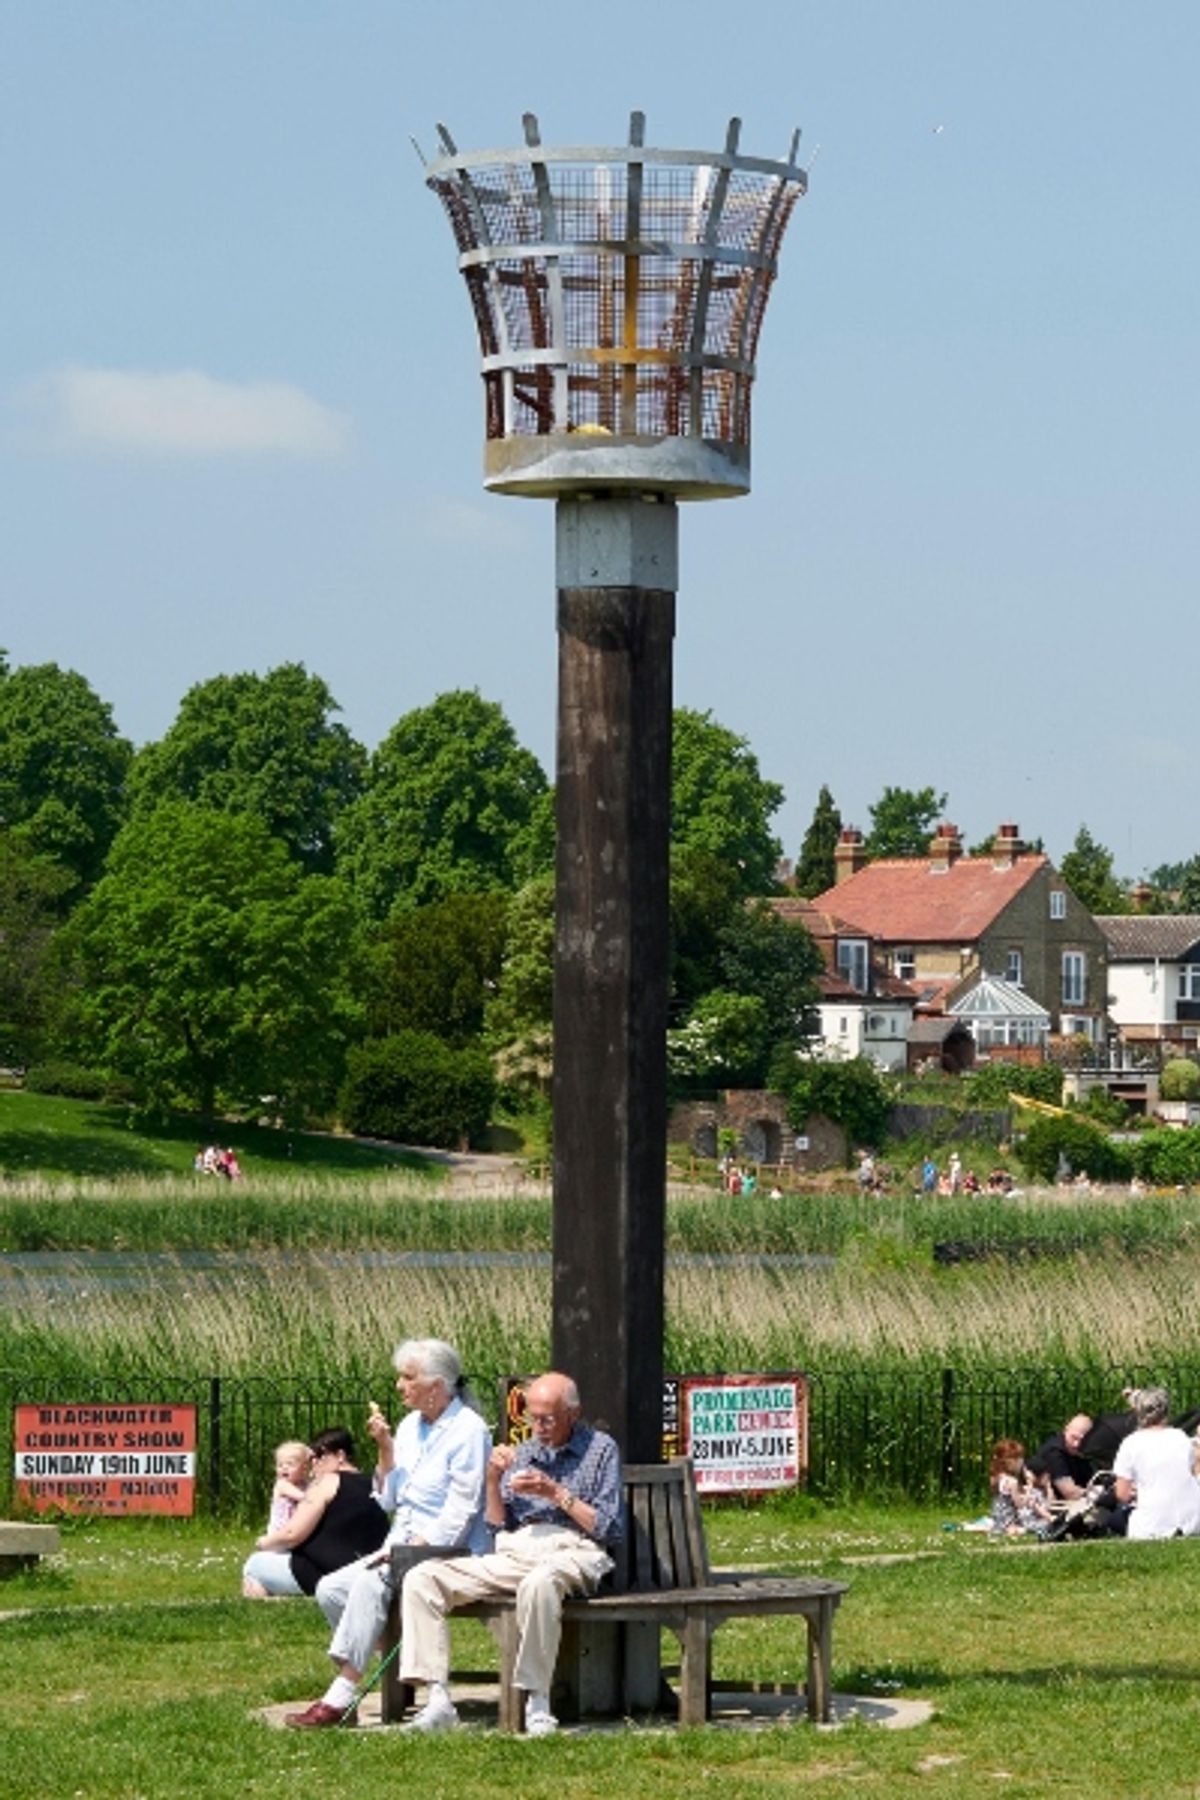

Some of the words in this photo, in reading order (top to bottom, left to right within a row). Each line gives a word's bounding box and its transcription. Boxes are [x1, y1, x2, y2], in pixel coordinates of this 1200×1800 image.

[38, 1409, 173, 1424] BLACKWATER
[692, 1412, 737, 1435] PARK
[25, 1431, 118, 1447] COUNTRY
[123, 1431, 185, 1447] SHOW
[23, 1455, 95, 1475] SUNDAY
[99, 1455, 140, 1475] 19th
[143, 1455, 188, 1475] JUNE
